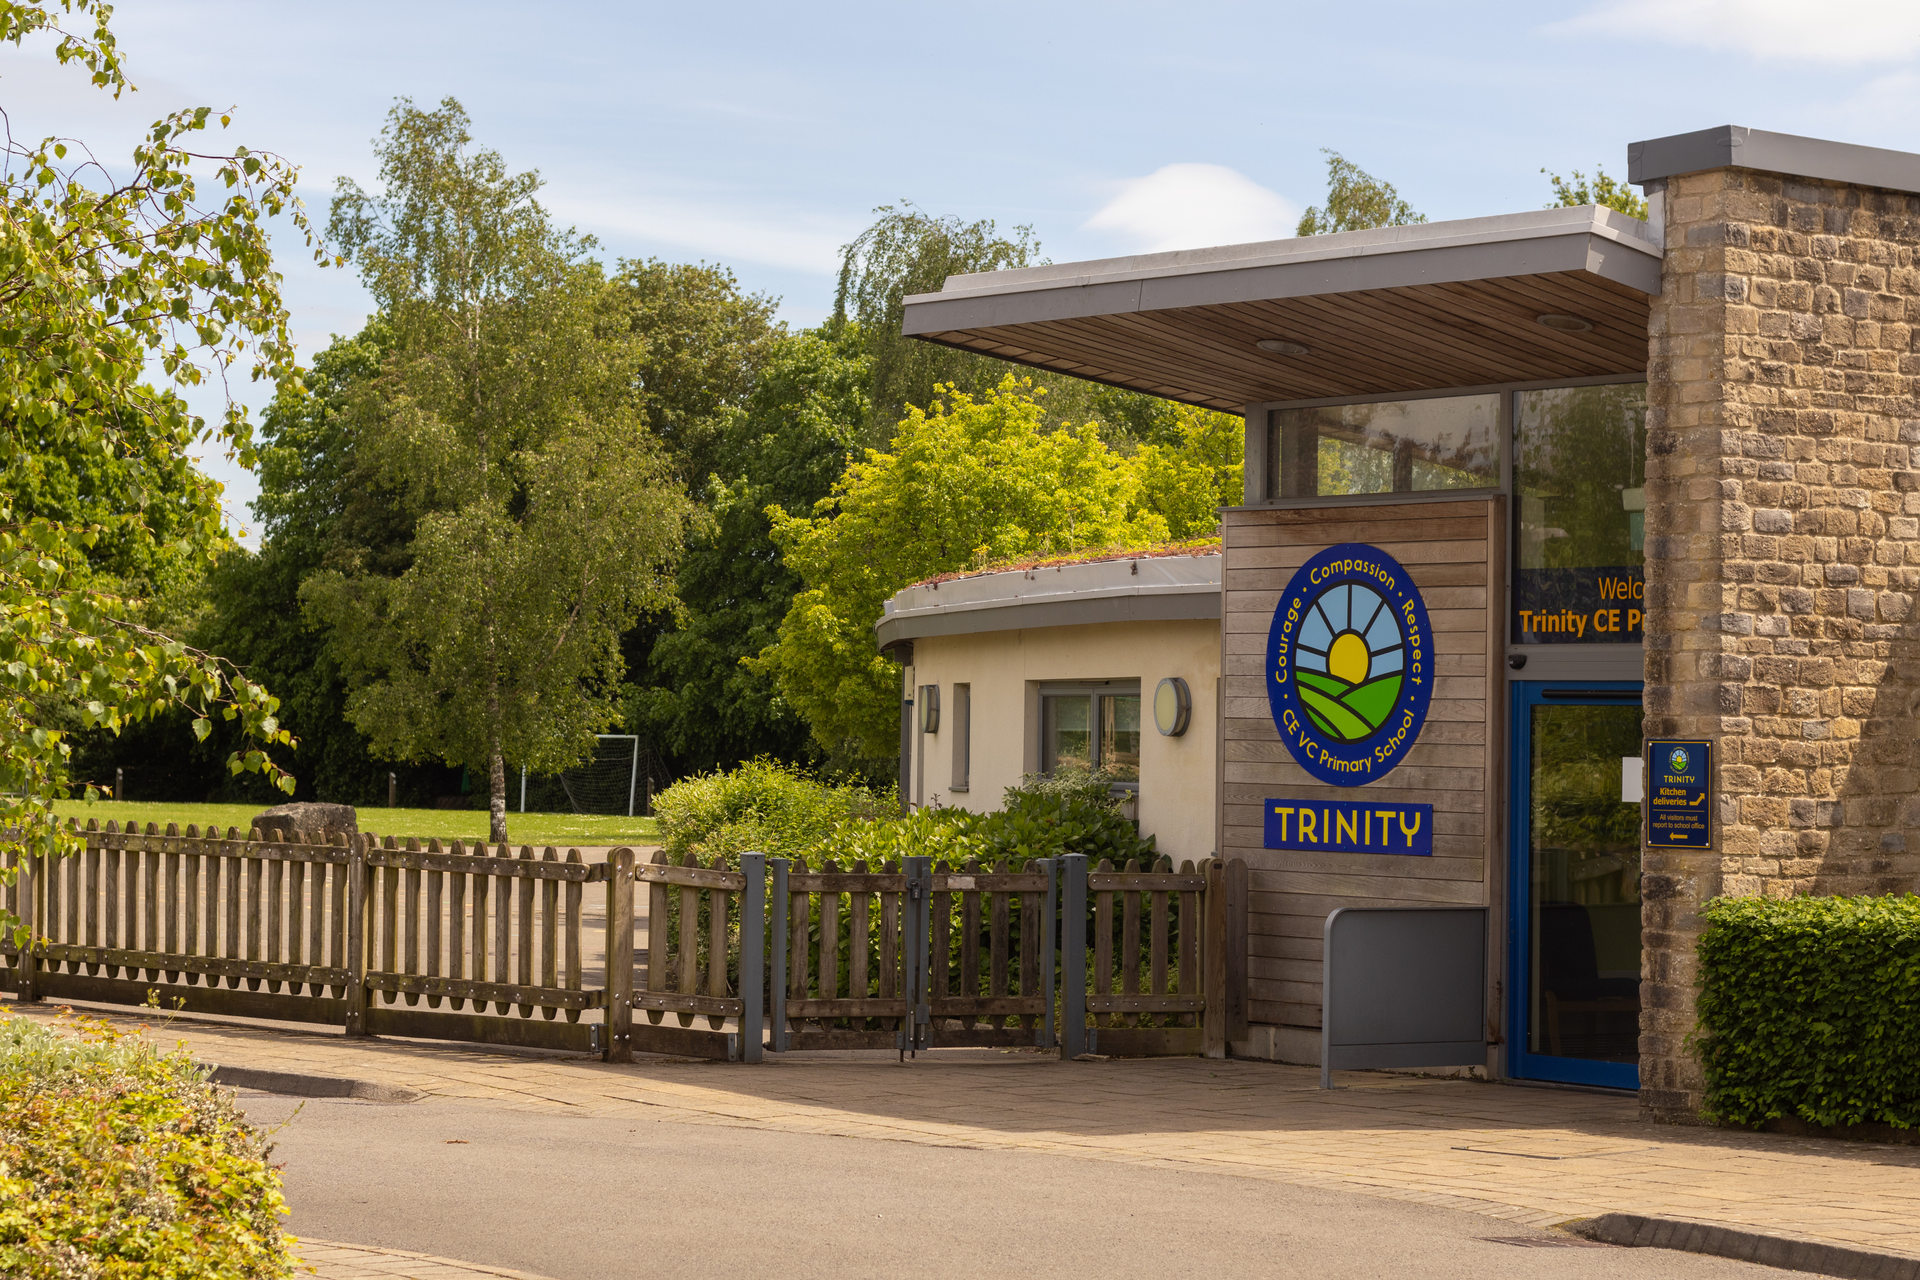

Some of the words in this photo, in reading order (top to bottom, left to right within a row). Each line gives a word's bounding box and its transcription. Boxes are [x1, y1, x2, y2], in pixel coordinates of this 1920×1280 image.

[1275, 597, 1302, 684] Courage
[1310, 558, 1396, 591] Compassion
[1402, 598, 1422, 686] Respect
[1519, 609, 1588, 638] Trinity
[1593, 608, 1620, 633] CE
[1282, 709, 1300, 736] CE
[1298, 735, 1319, 759] VC
[1318, 748, 1372, 773] Primary
[1375, 708, 1415, 763] School
[1660, 787, 1687, 796] Kitchen
[1664, 775, 1695, 783] TRINITY
[1653, 797, 1687, 806] deliveries
[1274, 806, 1421, 847] TRINITY
